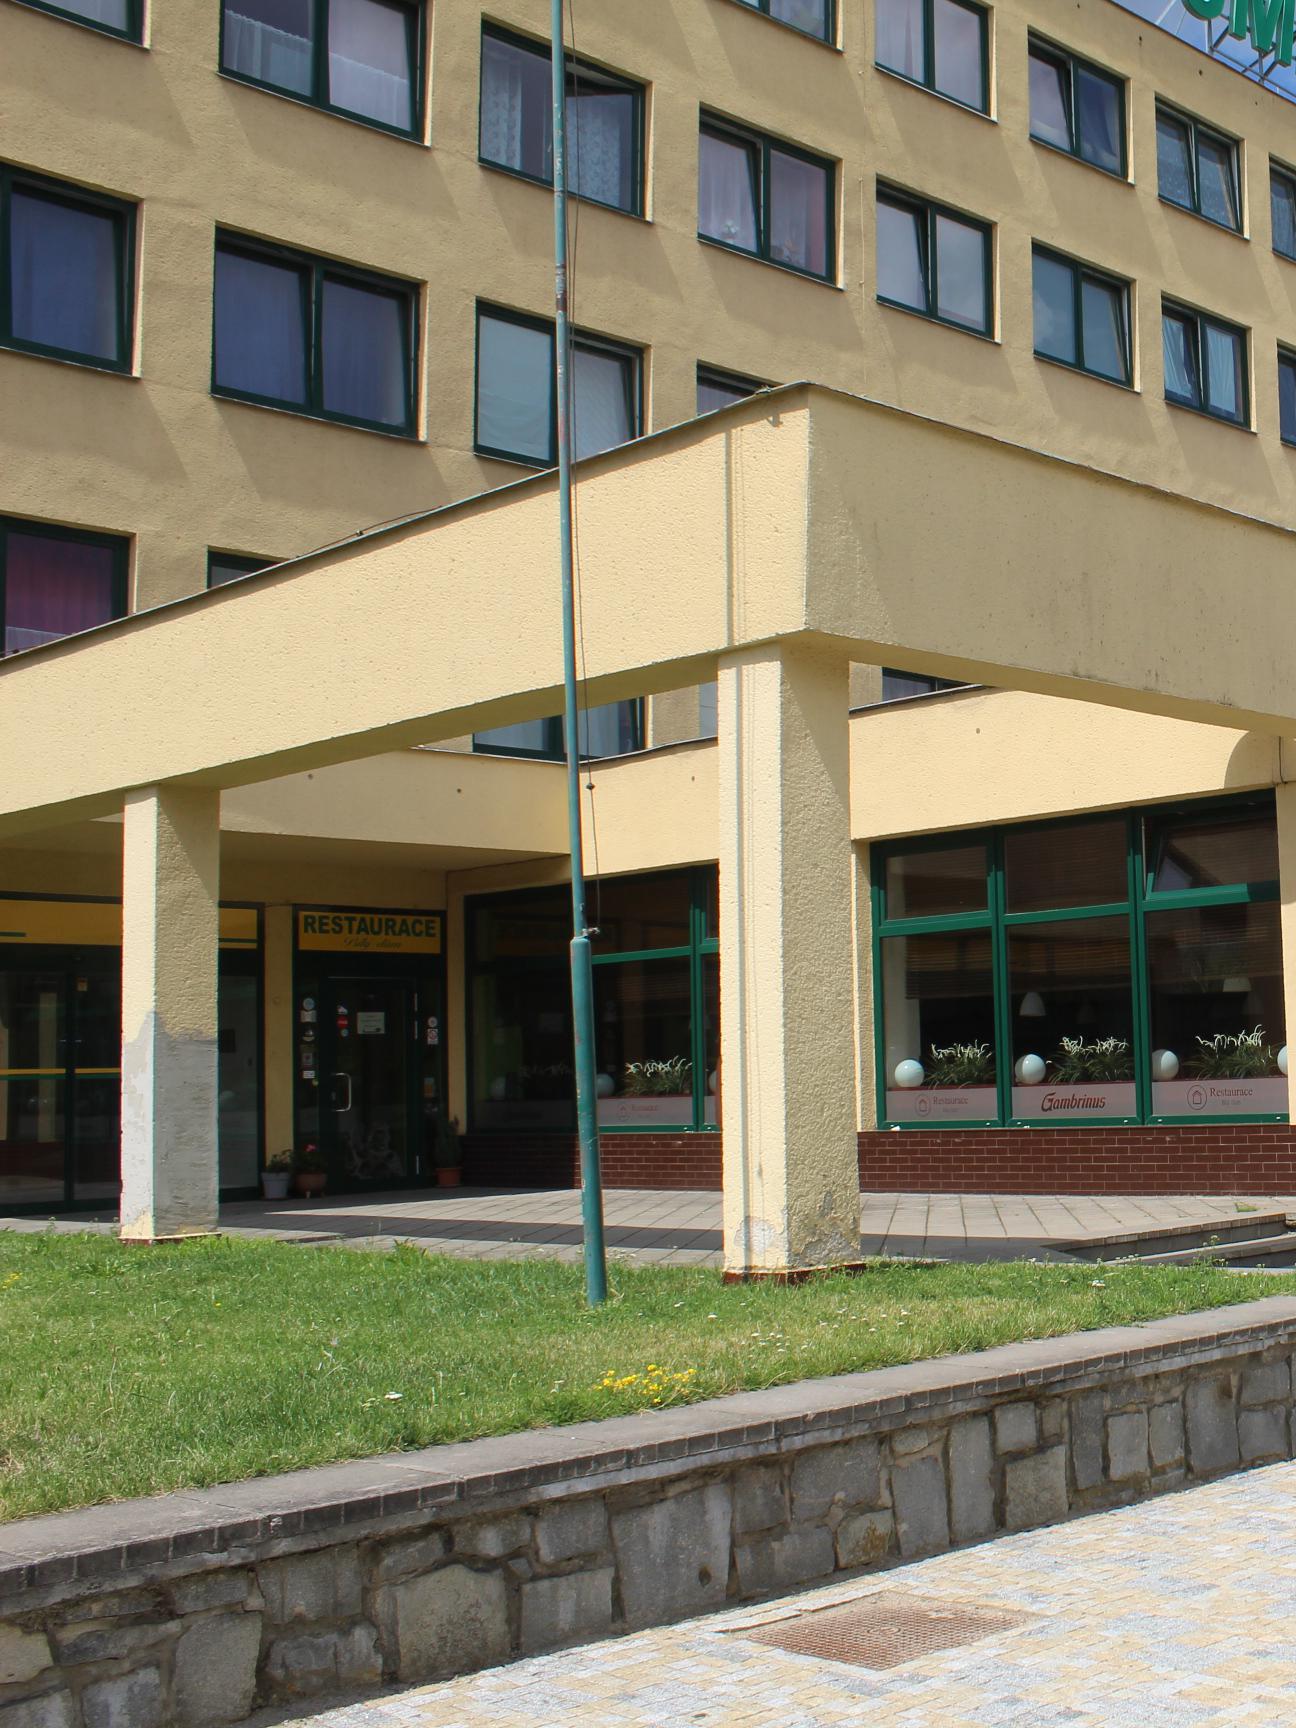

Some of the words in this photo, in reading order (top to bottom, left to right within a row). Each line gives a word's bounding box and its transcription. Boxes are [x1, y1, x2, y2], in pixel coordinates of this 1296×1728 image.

[303, 914, 437, 938] RESTAURACE
[1041, 1092, 1106, 1112] Gambrinus
[1210, 1087, 1253, 1097] Restaurace
